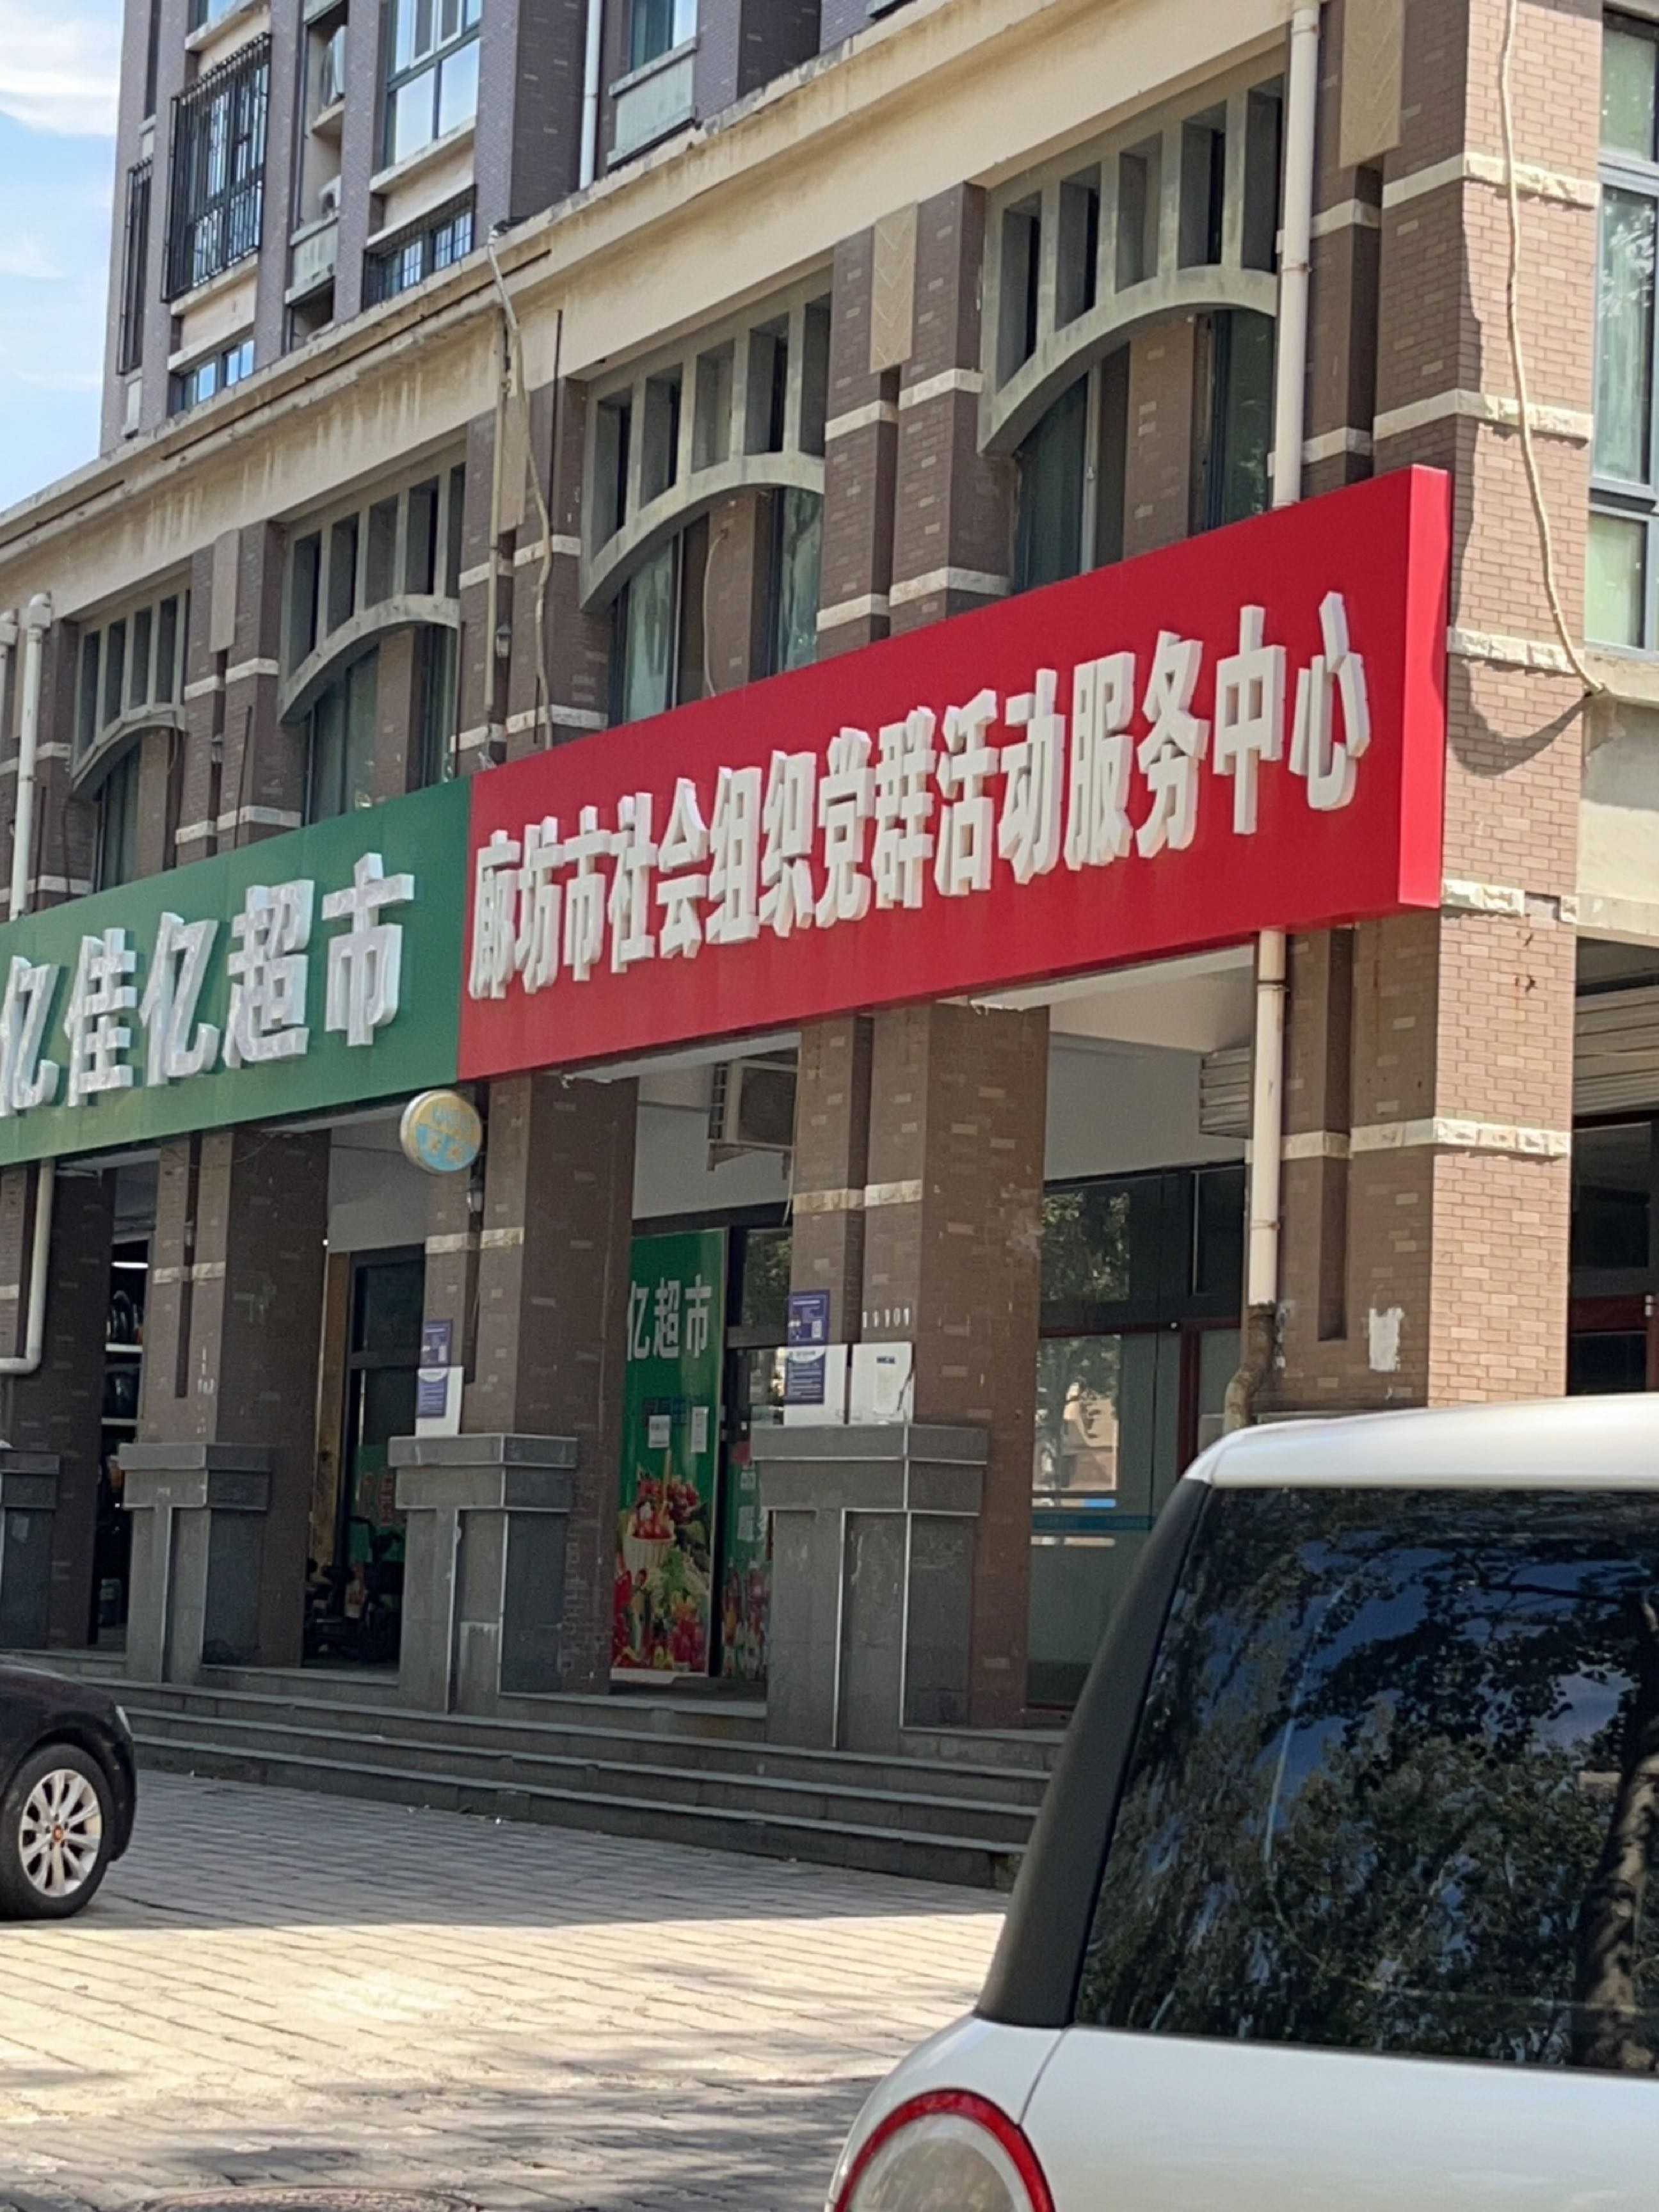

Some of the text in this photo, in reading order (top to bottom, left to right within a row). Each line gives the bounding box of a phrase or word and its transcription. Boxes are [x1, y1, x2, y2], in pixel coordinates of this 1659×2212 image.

[469, 591, 1371, 1000] 廊坊市社会组织党群活动服务中心
[0, 852, 415, 1117] 亿佳亿超市
[627, 1274, 712, 1361] 亿超市
